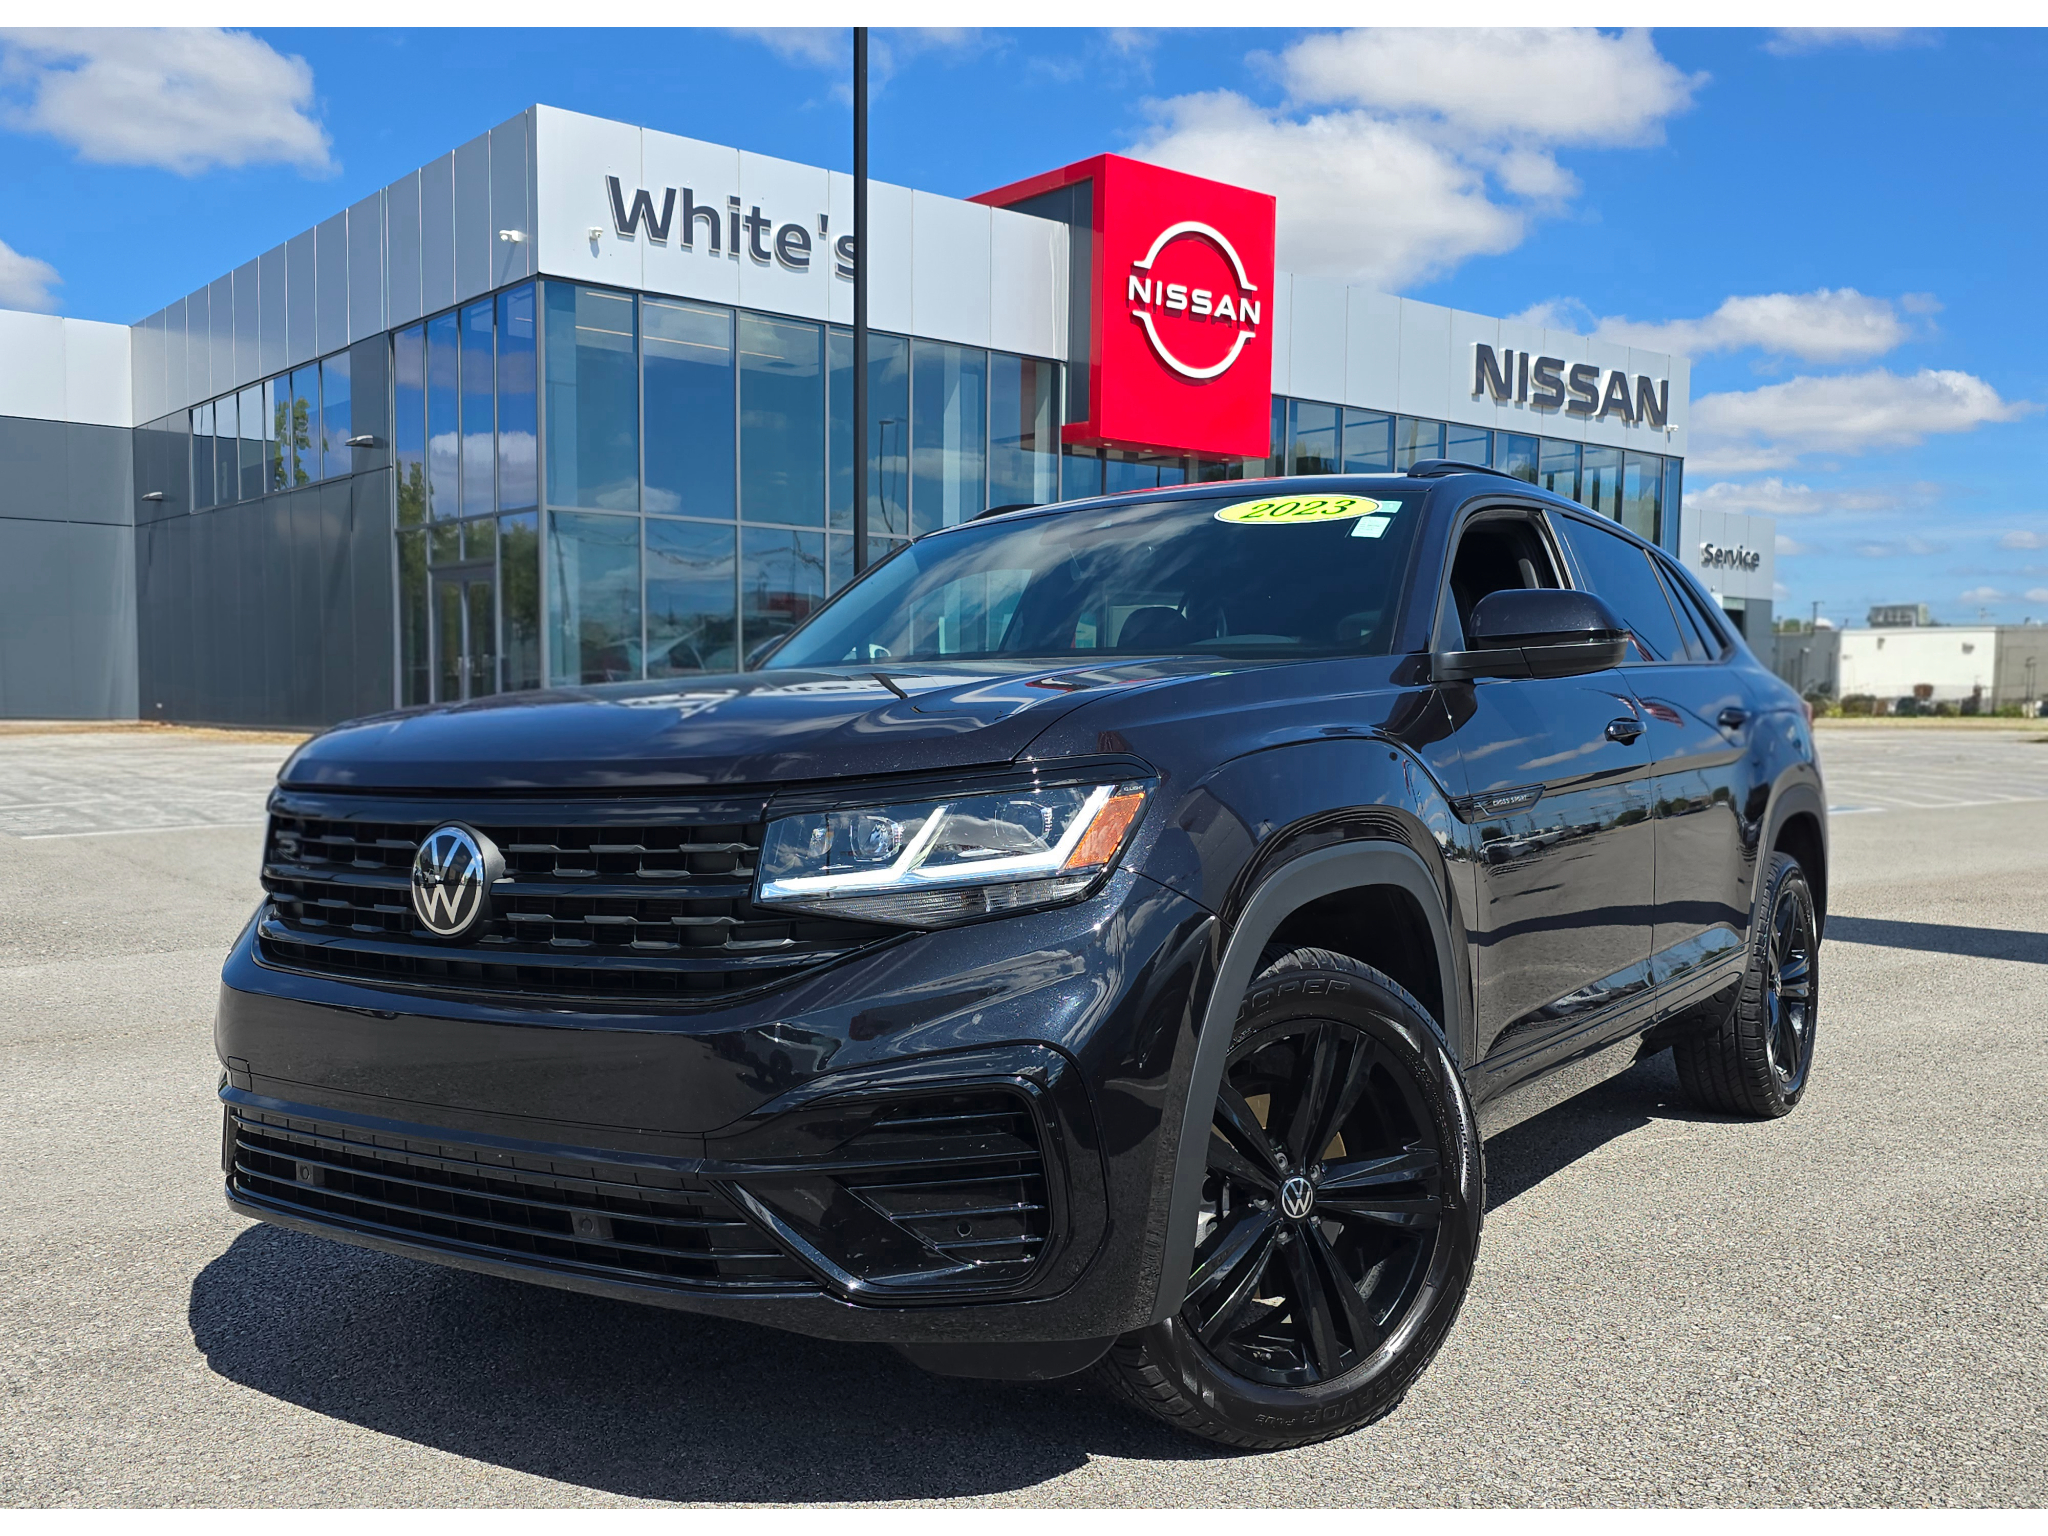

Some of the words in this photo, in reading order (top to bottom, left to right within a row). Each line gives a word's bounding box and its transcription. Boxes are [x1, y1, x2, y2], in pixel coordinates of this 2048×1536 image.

[605, 174, 854, 280] White's
[1128, 274, 1261, 325] NISSAN
[1470, 342, 1669, 427] NISSAN
[1239, 499, 1357, 519] 2023
[1701, 543, 1760, 568] Service
